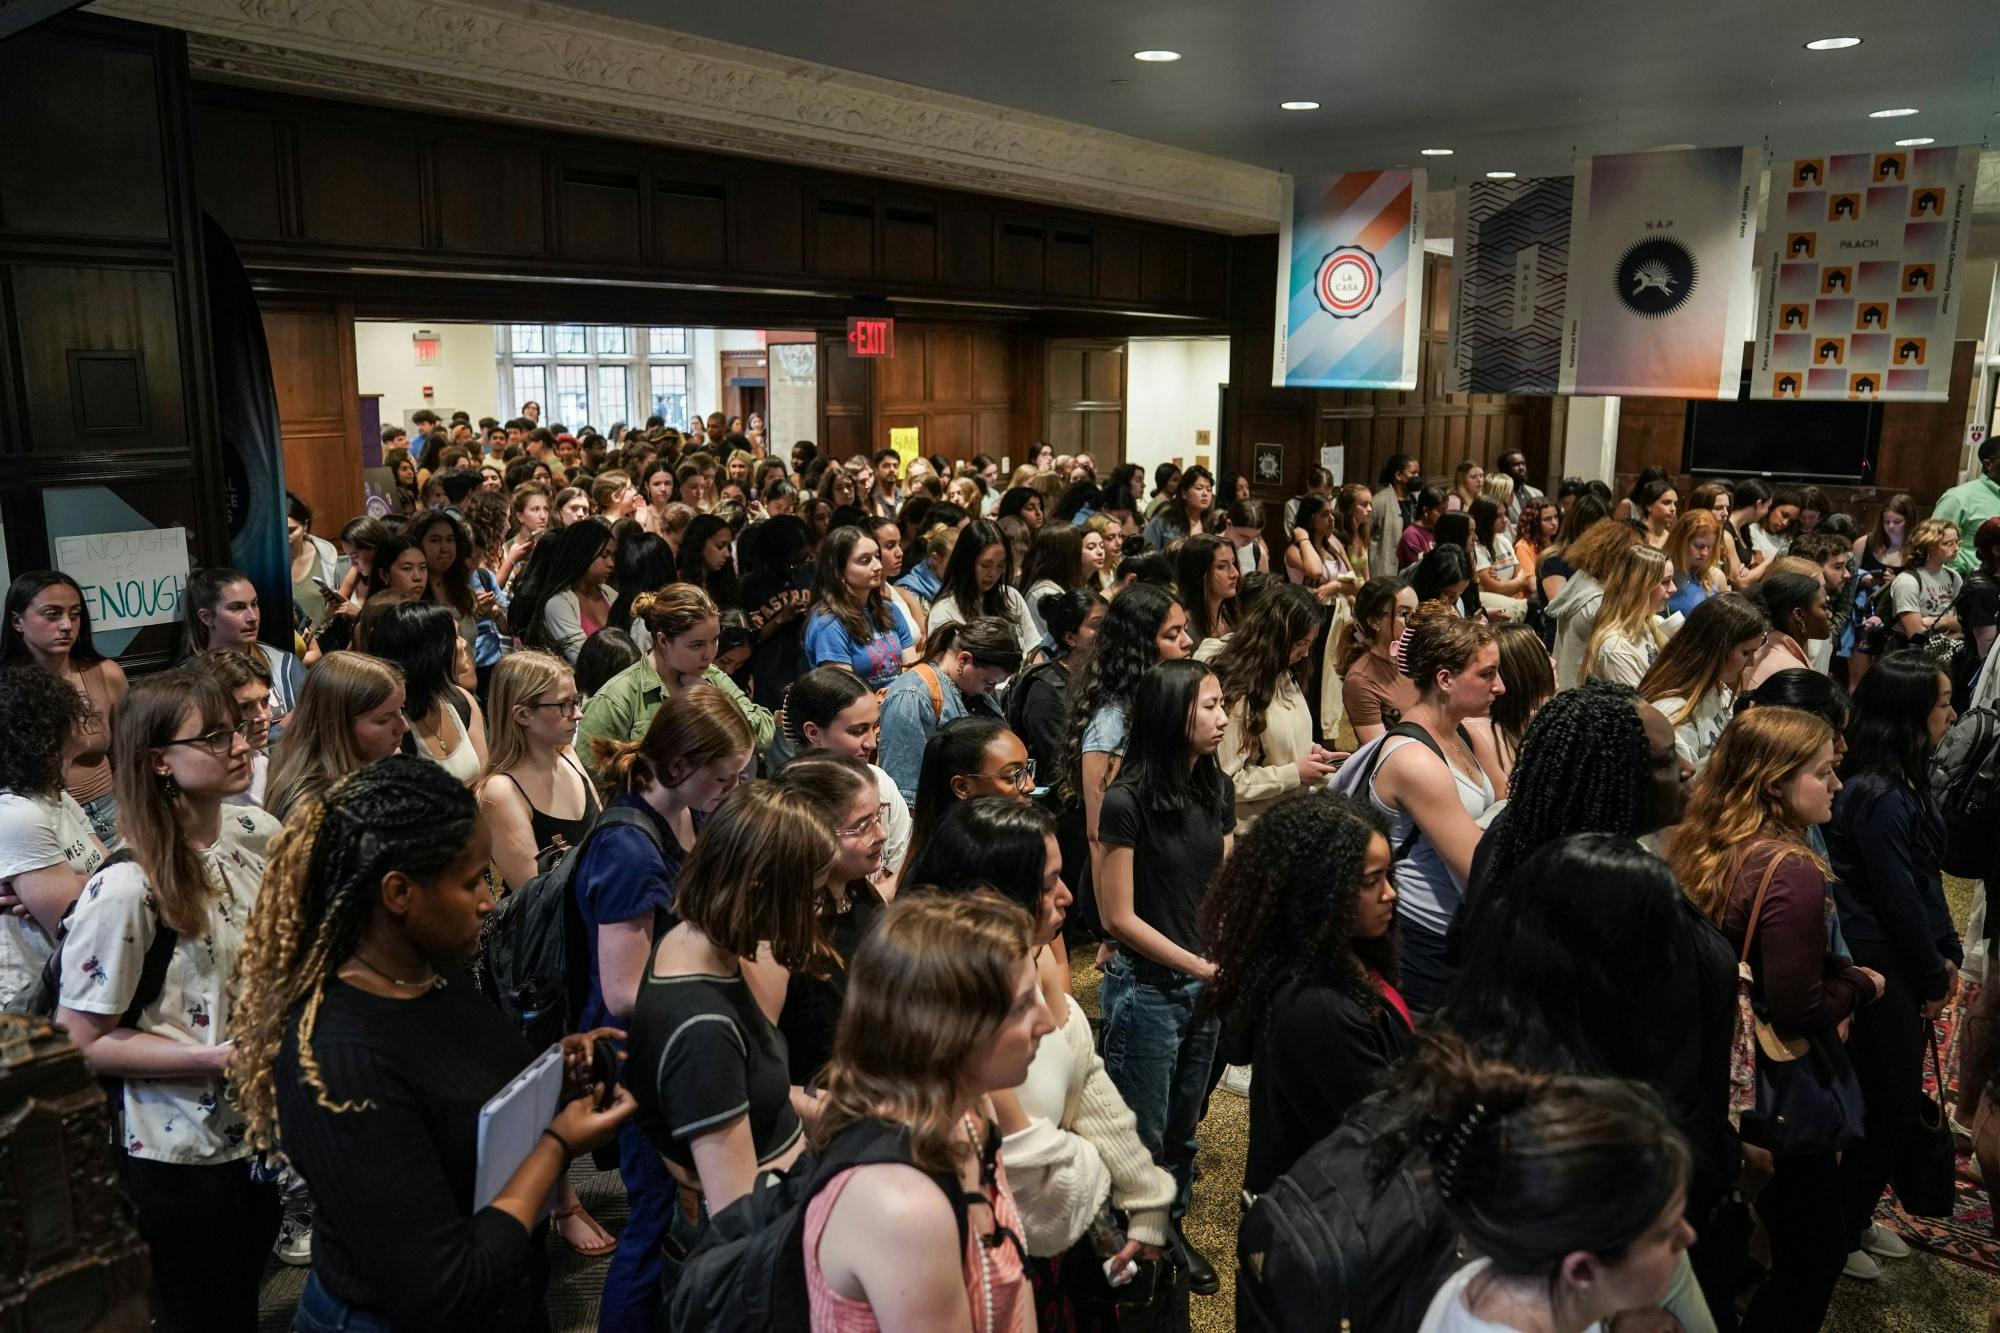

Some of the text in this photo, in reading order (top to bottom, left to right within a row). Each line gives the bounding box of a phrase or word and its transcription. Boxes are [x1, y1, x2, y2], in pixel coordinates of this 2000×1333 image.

[1742, 185, 1751, 211] Natives
[1645, 219, 1674, 230] NAP
[1839, 239, 1879, 249] PAACH
[1941, 183, 1966, 314] Pan-Asian American Community House
[1335, 283, 1359, 291] CASA
[1342, 273, 1353, 282] LA
[1520, 262, 1531, 313] MAKUU
[1767, 273, 1779, 309] Community
[857, 321, 887, 354] EXIT
[1765, 310, 1773, 340] American
[1569, 344, 1577, 368] Natives
[1761, 341, 1771, 371] Pan-Asian
[59, 528, 178, 566] ENOUGH
[109, 561, 136, 580] IS
[80, 573, 188, 622] ENOUGH
